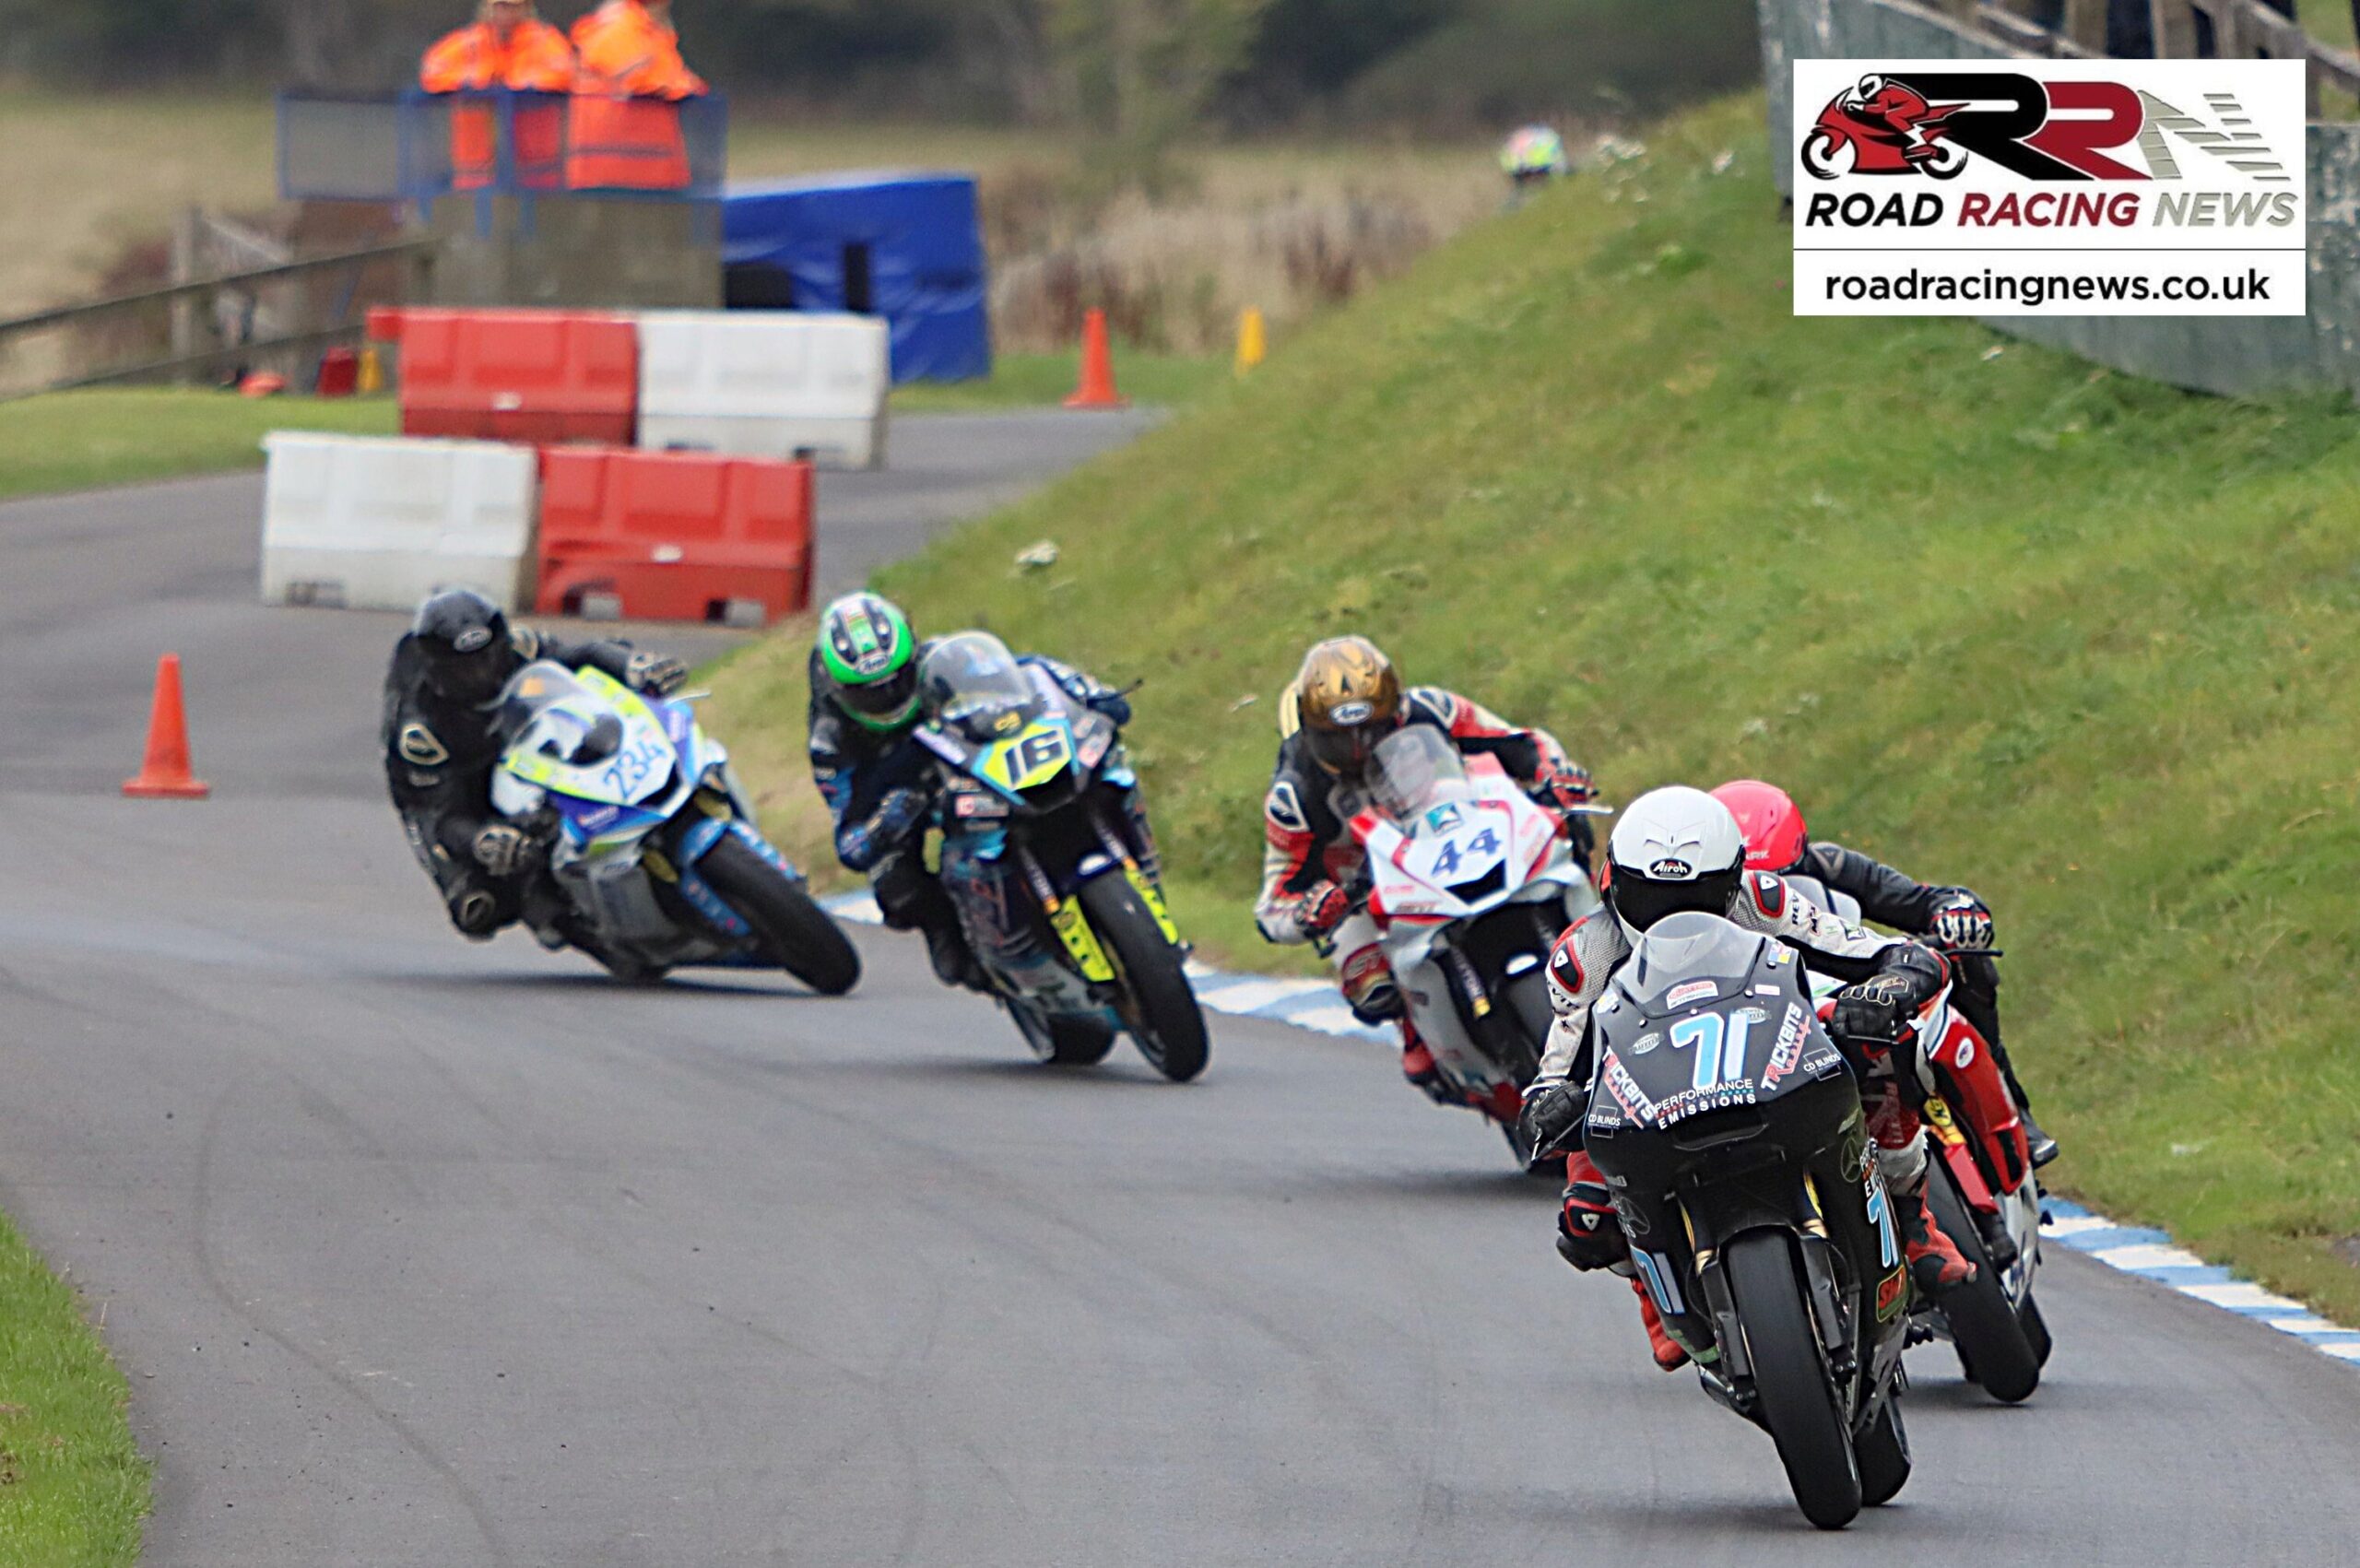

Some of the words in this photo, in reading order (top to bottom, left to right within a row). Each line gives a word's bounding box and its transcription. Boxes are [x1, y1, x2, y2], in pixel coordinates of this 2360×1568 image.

[603, 738, 667, 800] 234
[1004, 728, 1063, 785] 16
[1431, 828, 1503, 876] 44
[1653, 860, 1688, 873] Airoh
[1670, 1011, 1750, 1091] 71
[1761, 1001, 1802, 1091] TRICKBITS
[1803, 1062, 1816, 1072] CD
[1814, 1053, 1842, 1067] BLINDS
[1602, 1045, 1657, 1123] TRICKBITS
[1653, 1078, 1753, 1114] PERFORMANCE
[1597, 1114, 1622, 1126] BLINDS
[1658, 1093, 1756, 1130] EMISSIONS
